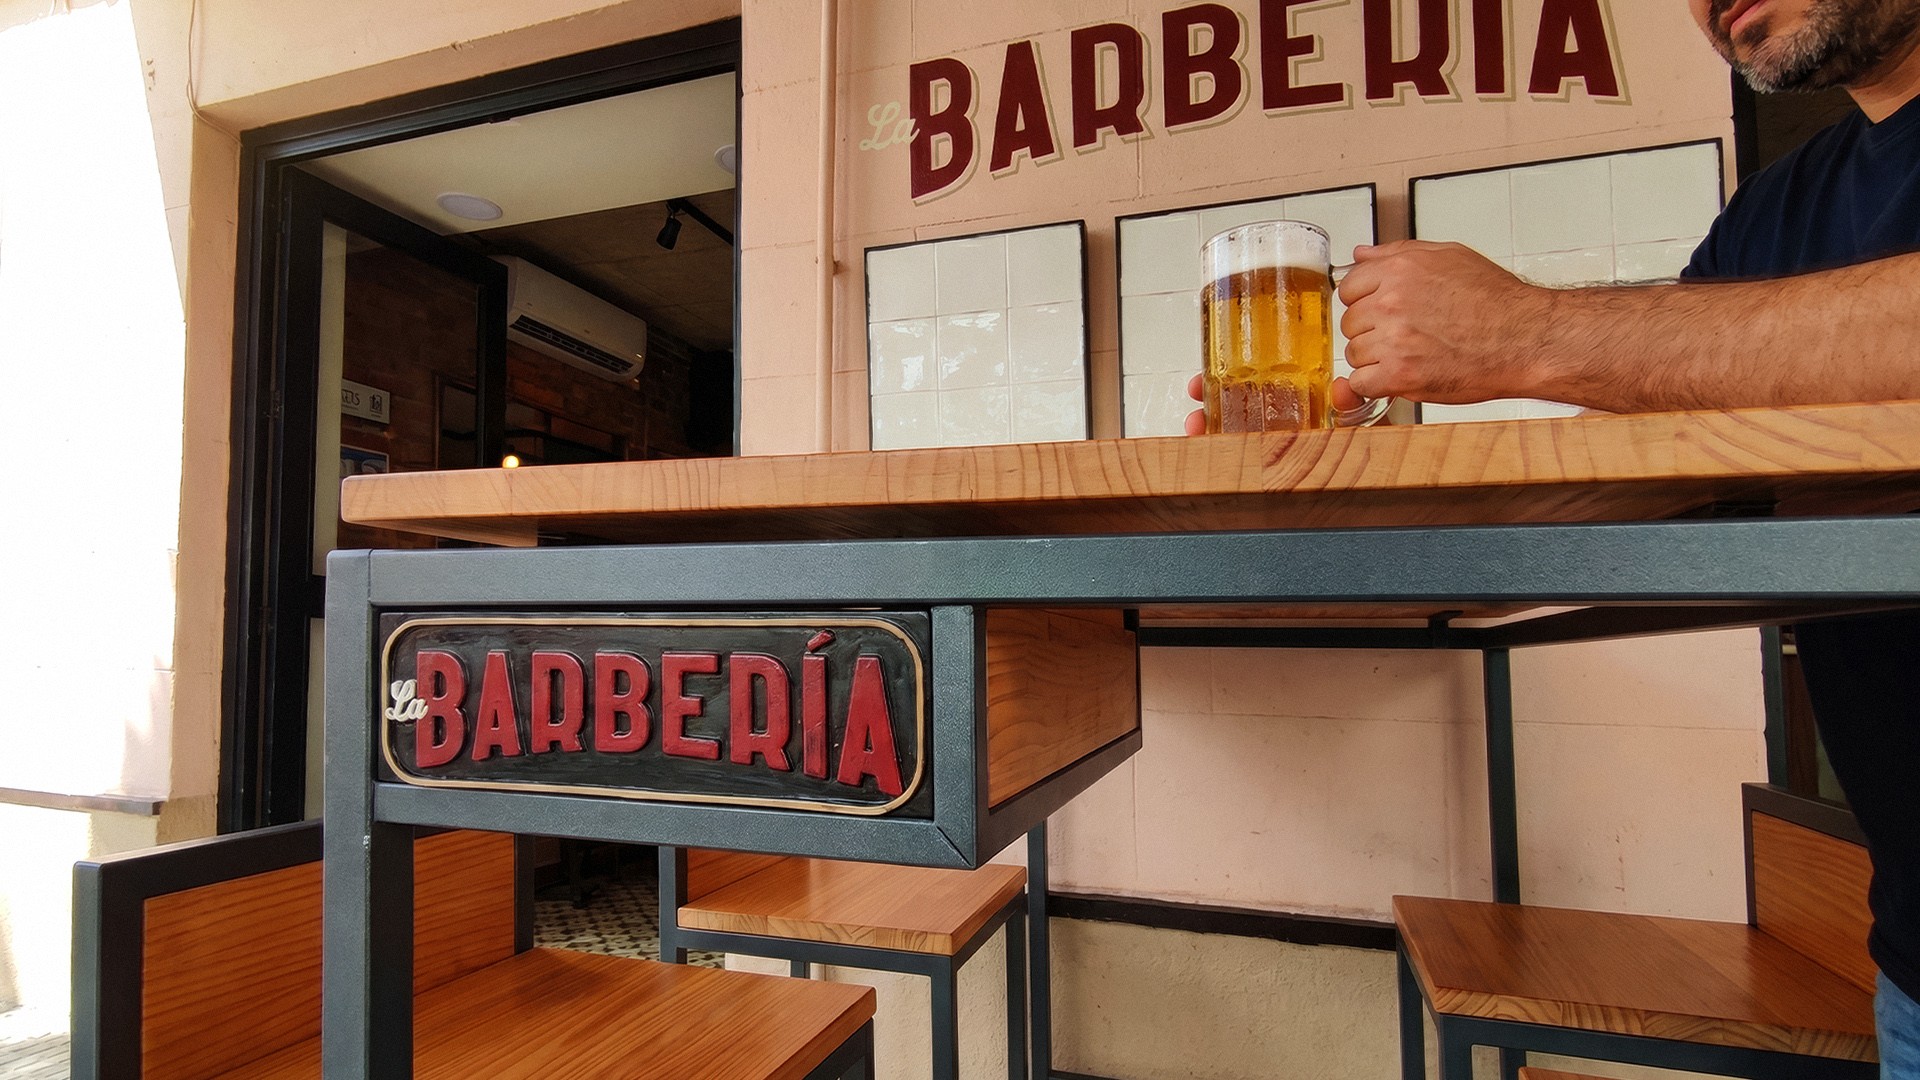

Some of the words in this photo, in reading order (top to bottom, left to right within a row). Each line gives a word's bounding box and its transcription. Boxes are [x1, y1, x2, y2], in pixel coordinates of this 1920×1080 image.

[860, 101, 920, 151] La
[385, 679, 429, 722] La
[416, 629, 902, 797] BARBERÍA
